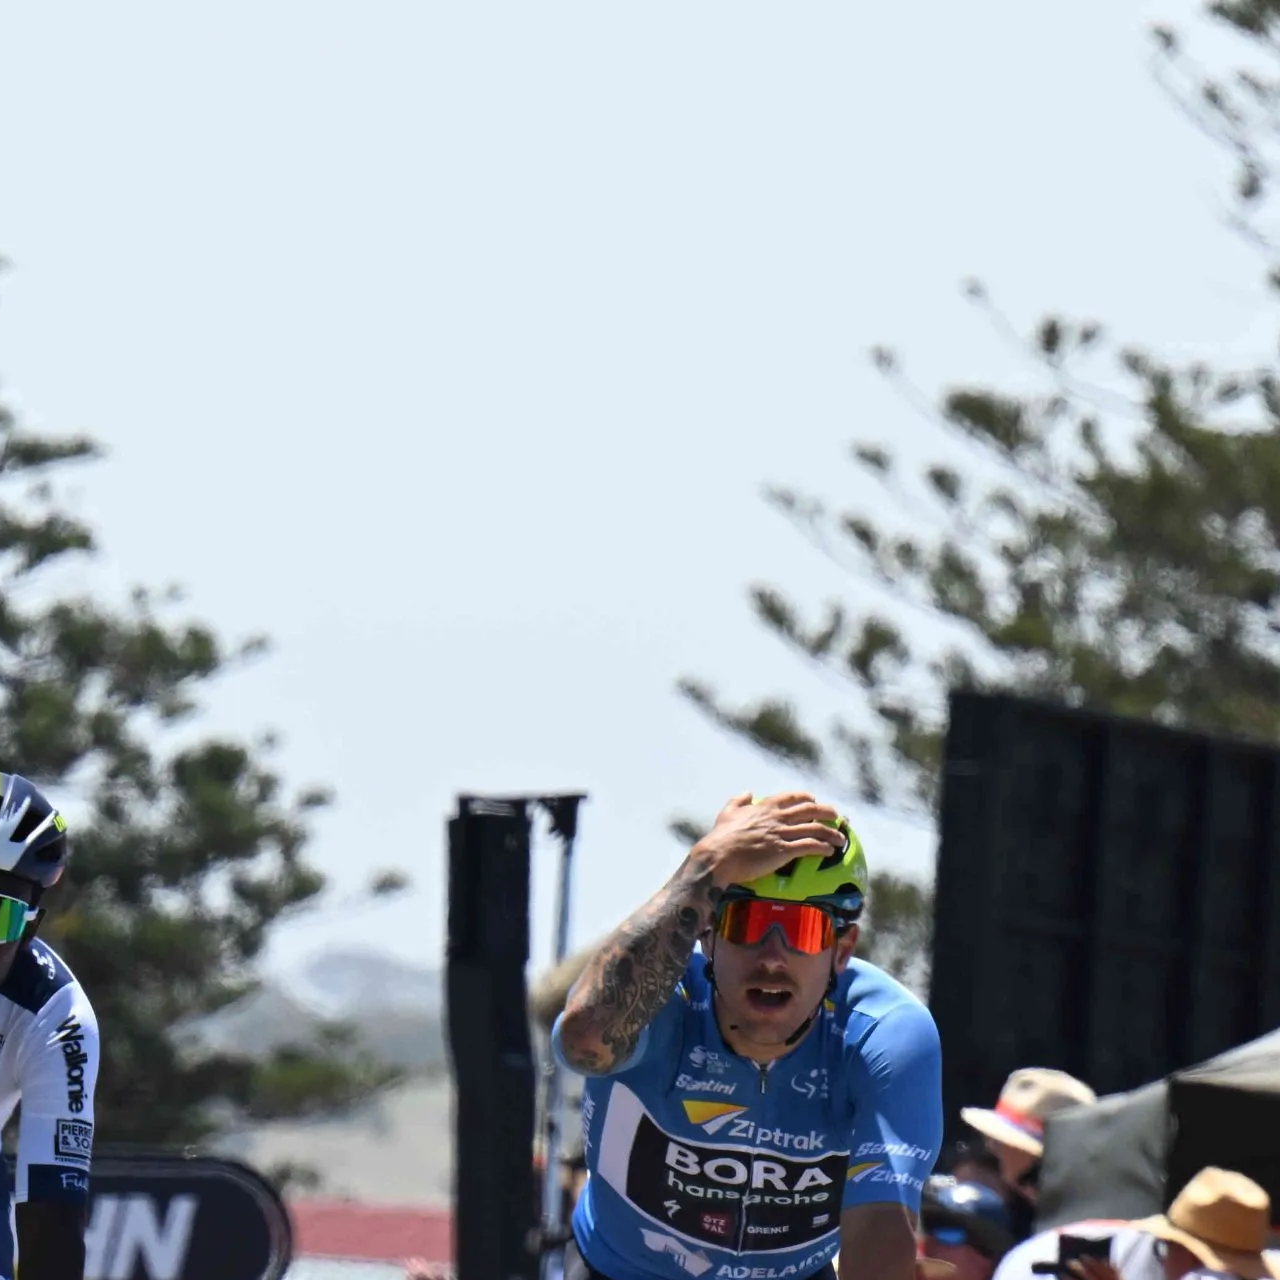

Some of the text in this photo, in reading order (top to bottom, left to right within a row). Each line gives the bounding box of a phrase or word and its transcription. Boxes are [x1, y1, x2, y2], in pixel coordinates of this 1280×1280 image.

[57, 1014, 88, 1115] Wallonie
[675, 1073, 738, 1096] Santini
[728, 1119, 826, 1151] Ziptrak
[855, 1142, 932, 1161] Santini
[664, 1141, 833, 1192] BORA
[870, 1169, 924, 1190] Ziptra
[668, 1170, 830, 1206] hansgrohe
[746, 1225, 790, 1235] GRENKE
